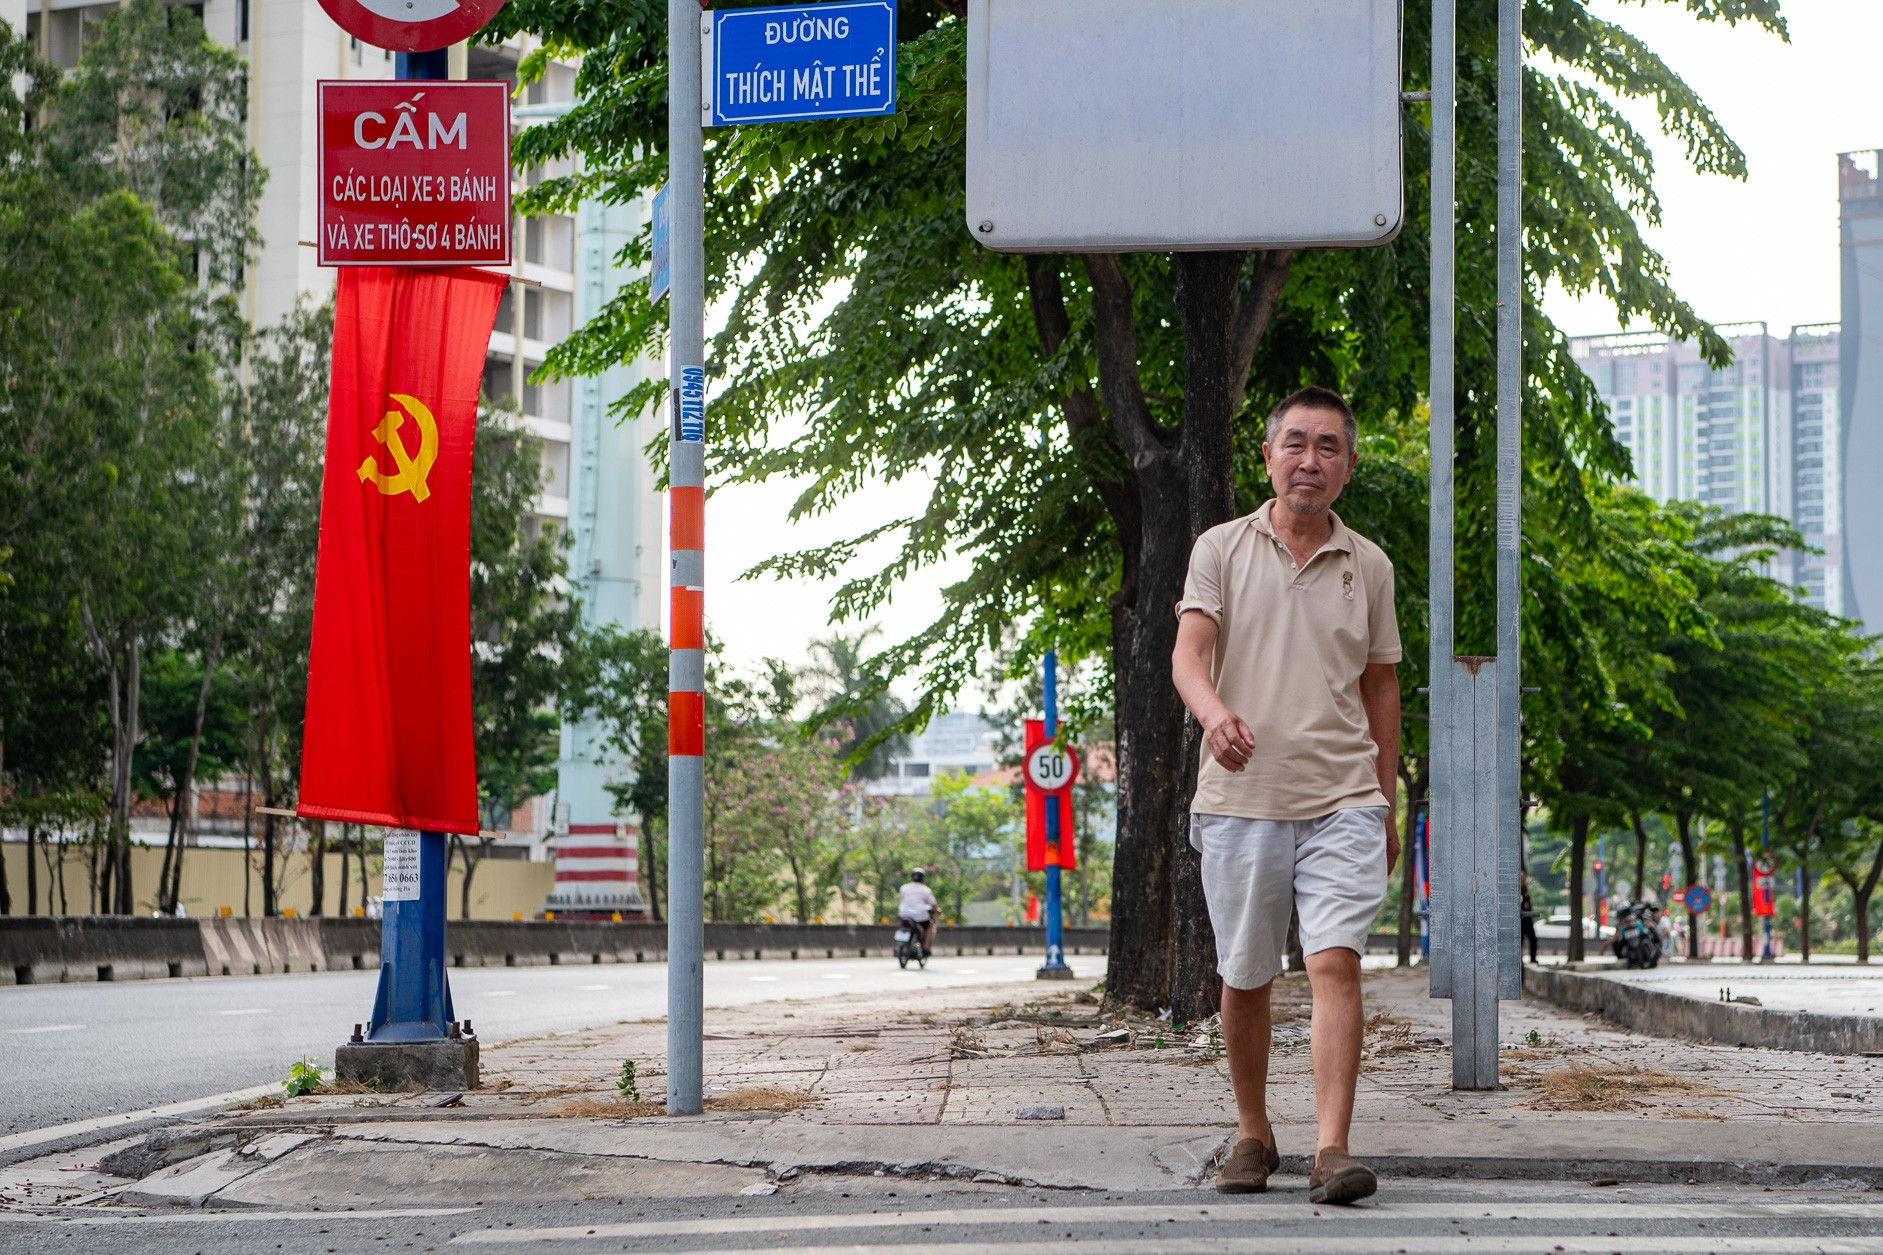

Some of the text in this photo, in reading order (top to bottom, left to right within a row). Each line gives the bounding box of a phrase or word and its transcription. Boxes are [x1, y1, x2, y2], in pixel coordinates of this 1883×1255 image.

[765, 12, 849, 45] ĐƯỜNG
[726, 47, 885, 107] THÍCH MẬT THỂ
[353, 92, 467, 150] CẤM
[332, 167, 496, 209] CÁC LOẠI XE 3 BÁNH
[327, 216, 501, 250] VÀ XE THÔ SƠ 4 BÁNH
[1039, 755, 1063, 779] 50
[399, 872, 419, 883] 0663
